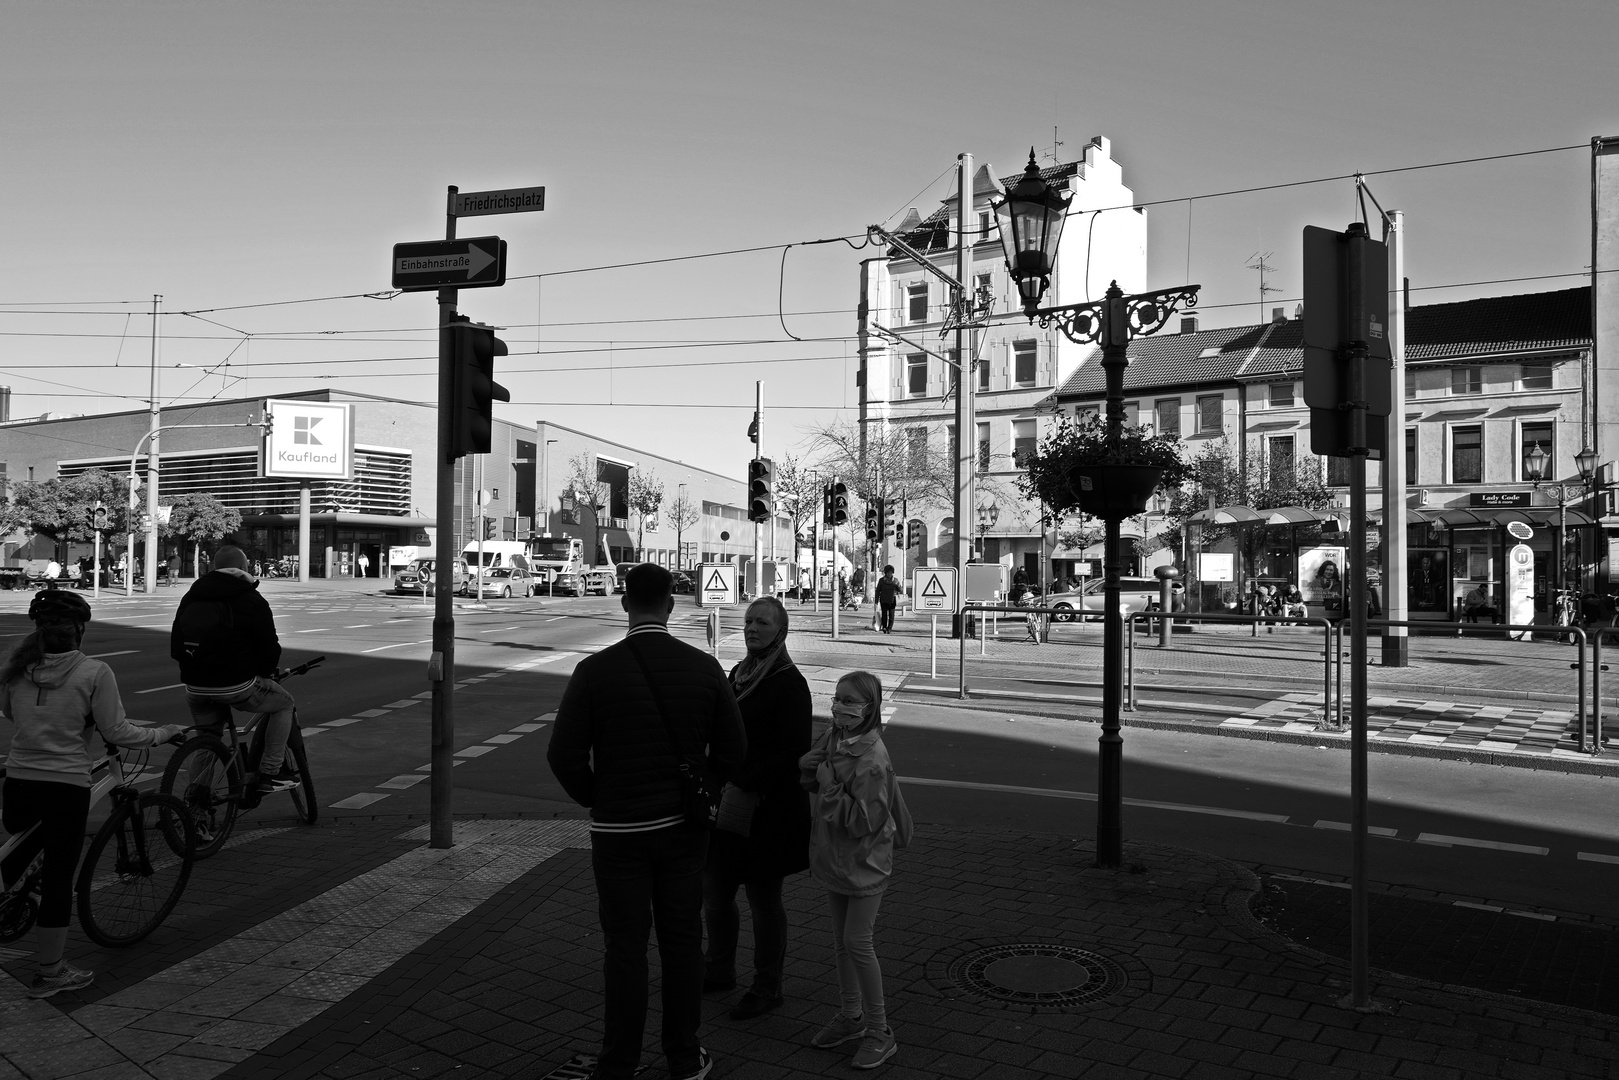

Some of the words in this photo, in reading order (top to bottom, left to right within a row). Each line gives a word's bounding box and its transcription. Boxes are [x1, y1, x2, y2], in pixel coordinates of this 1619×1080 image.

[464, 193, 542, 212] Friedrichsplatz
[401, 256, 470, 270] Einbahnstraße
[278, 451, 337, 463] Kaufland
